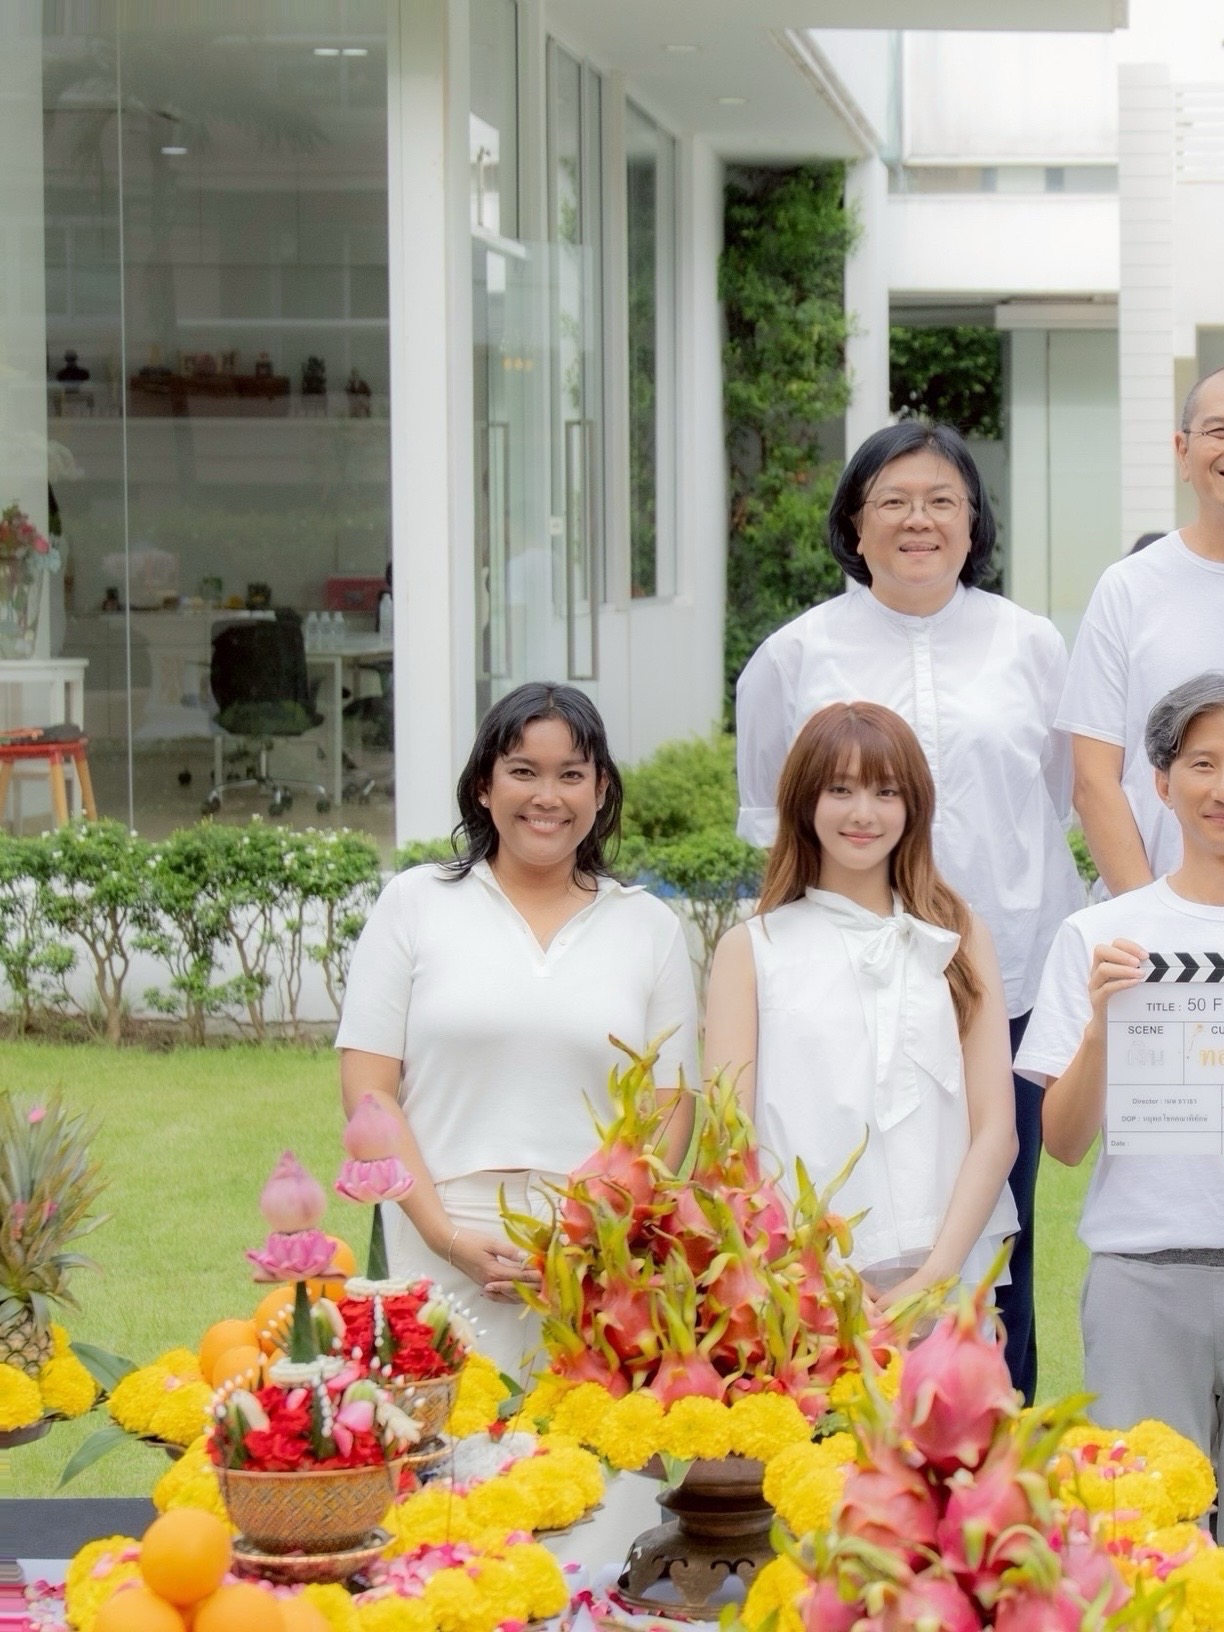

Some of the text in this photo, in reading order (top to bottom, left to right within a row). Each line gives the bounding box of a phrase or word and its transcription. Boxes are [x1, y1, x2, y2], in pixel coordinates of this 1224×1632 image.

[1146, 1002, 1175, 1012] TITLE
[1187, 997, 1207, 1012] 50
[1127, 1025, 1164, 1035] SCENE
[1121, 1115, 1137, 1123] DOP
